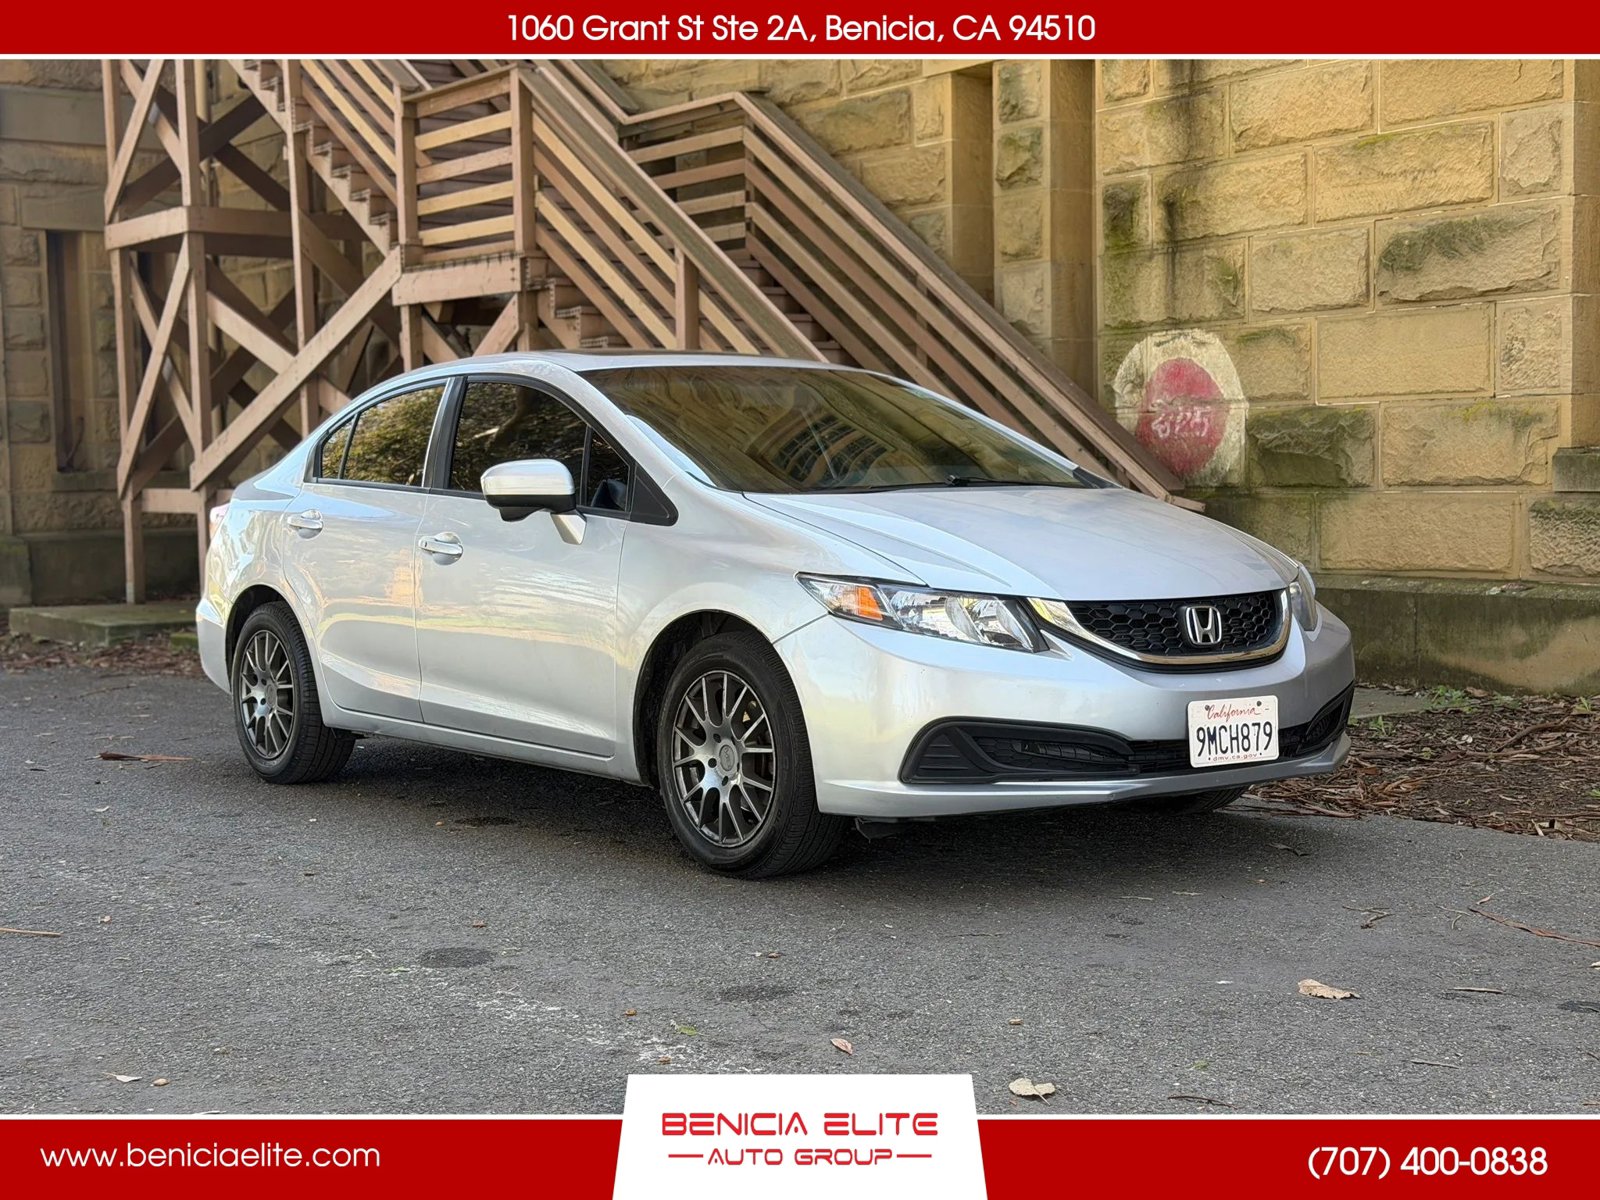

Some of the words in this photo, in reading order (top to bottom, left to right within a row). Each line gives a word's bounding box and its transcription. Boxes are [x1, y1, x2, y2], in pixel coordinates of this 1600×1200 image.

[1207, 704, 1261, 722] California
[1196, 721, 1273, 757] 9MCH879
[1212, 753, 1258, 762] dmv.ca.gov
